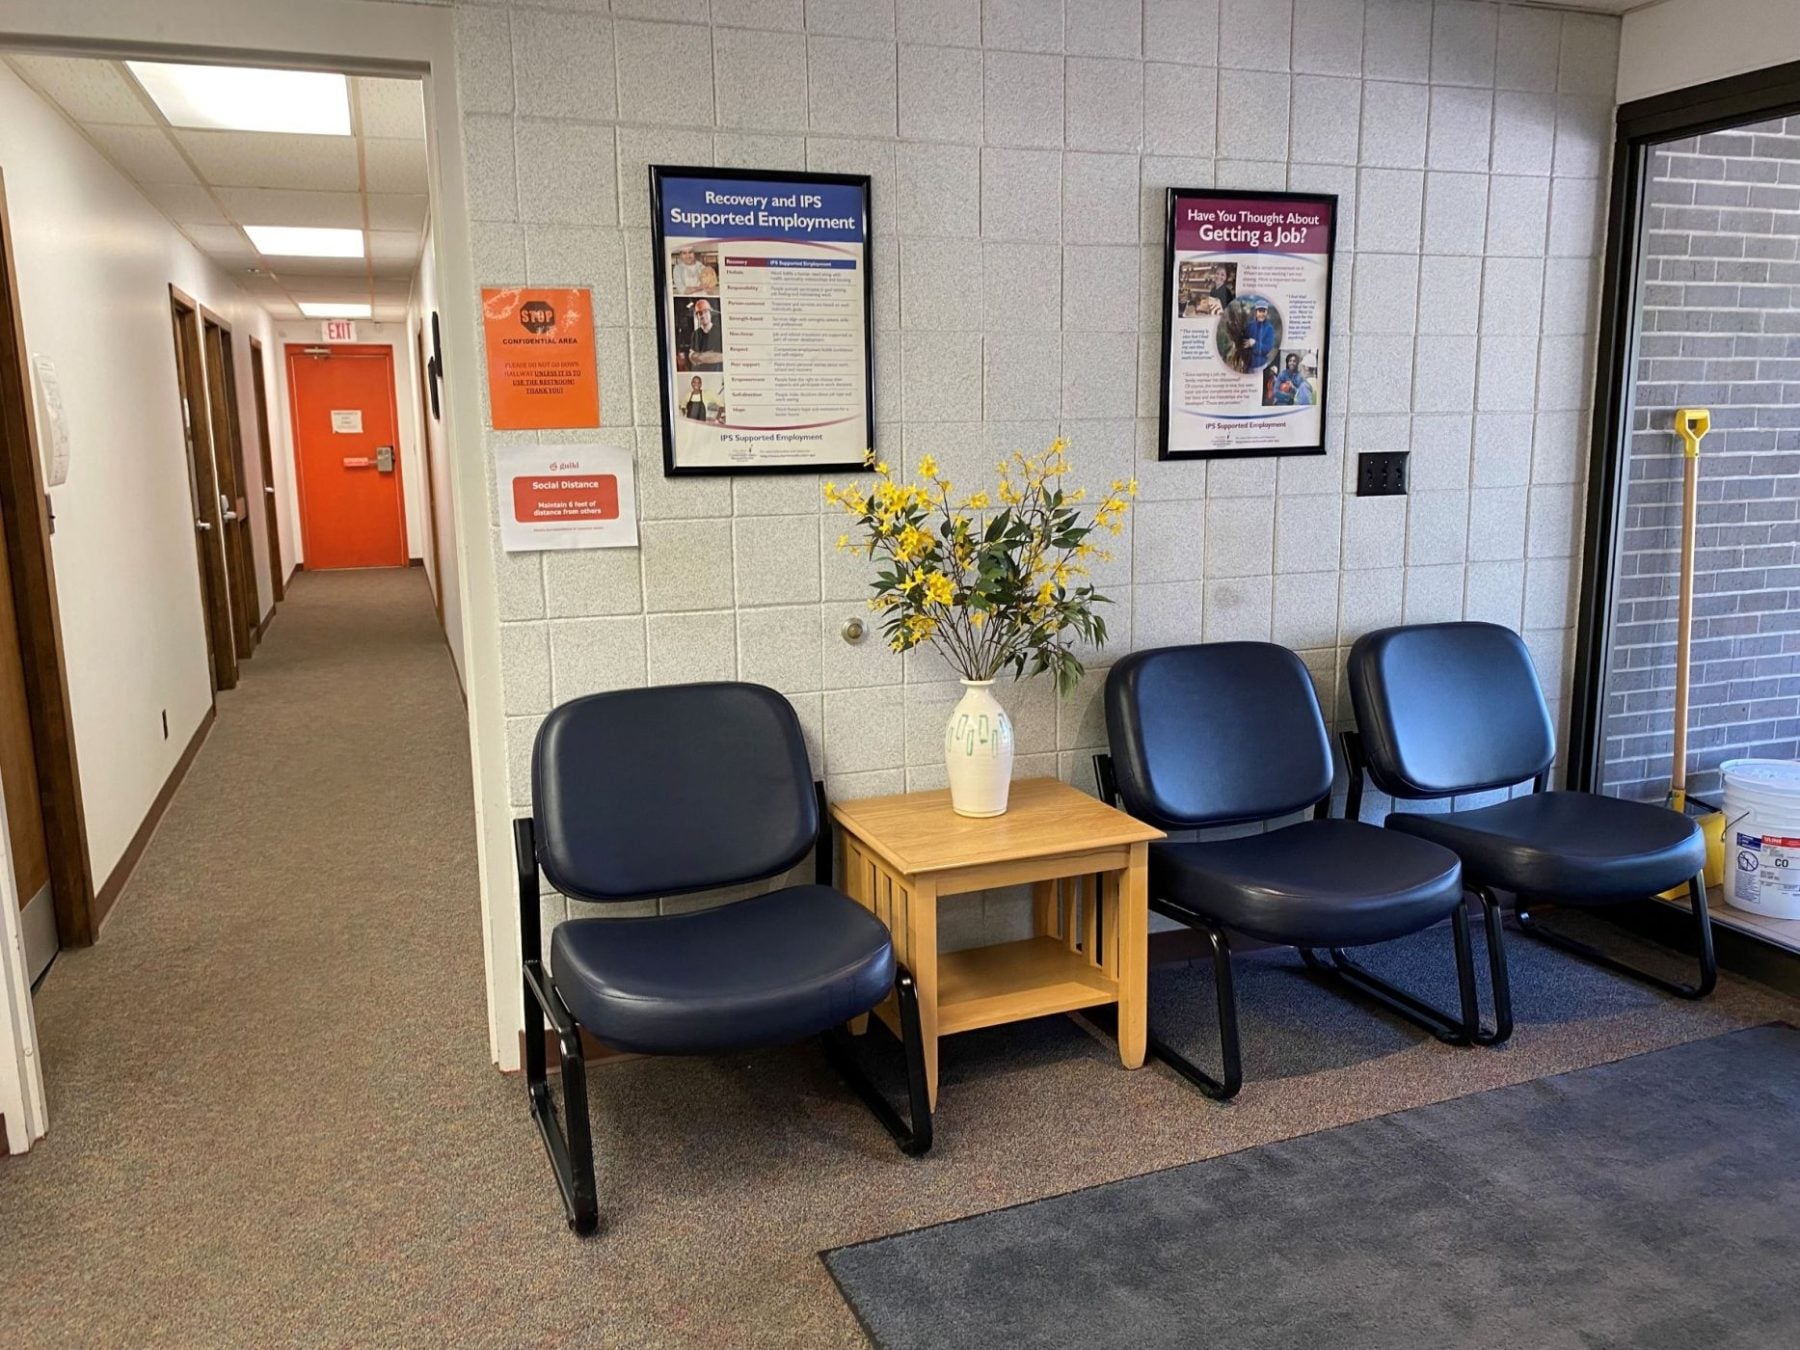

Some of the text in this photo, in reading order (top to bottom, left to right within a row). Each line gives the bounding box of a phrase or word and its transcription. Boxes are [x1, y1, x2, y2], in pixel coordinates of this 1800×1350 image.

[705, 191, 822, 210] Recovery and IPS
[670, 207, 855, 232] Supported Employment
[1188, 209, 1320, 227] Have You Thought About
[1199, 224, 1307, 247] Getting a Job?
[521, 310, 553, 323] STOP
[327, 322, 352, 340] EXIT
[558, 337, 578, 345] AREA
[526, 387, 549, 395] THANK
[1217, 422, 1248, 431] Supported
[1249, 421, 1287, 430] Employment
[720, 433, 823, 443] IPS Supported Employment
[559, 461, 579, 471] guild
[532, 480, 599, 490] Social Distance
[533, 509, 562, 517] distance
